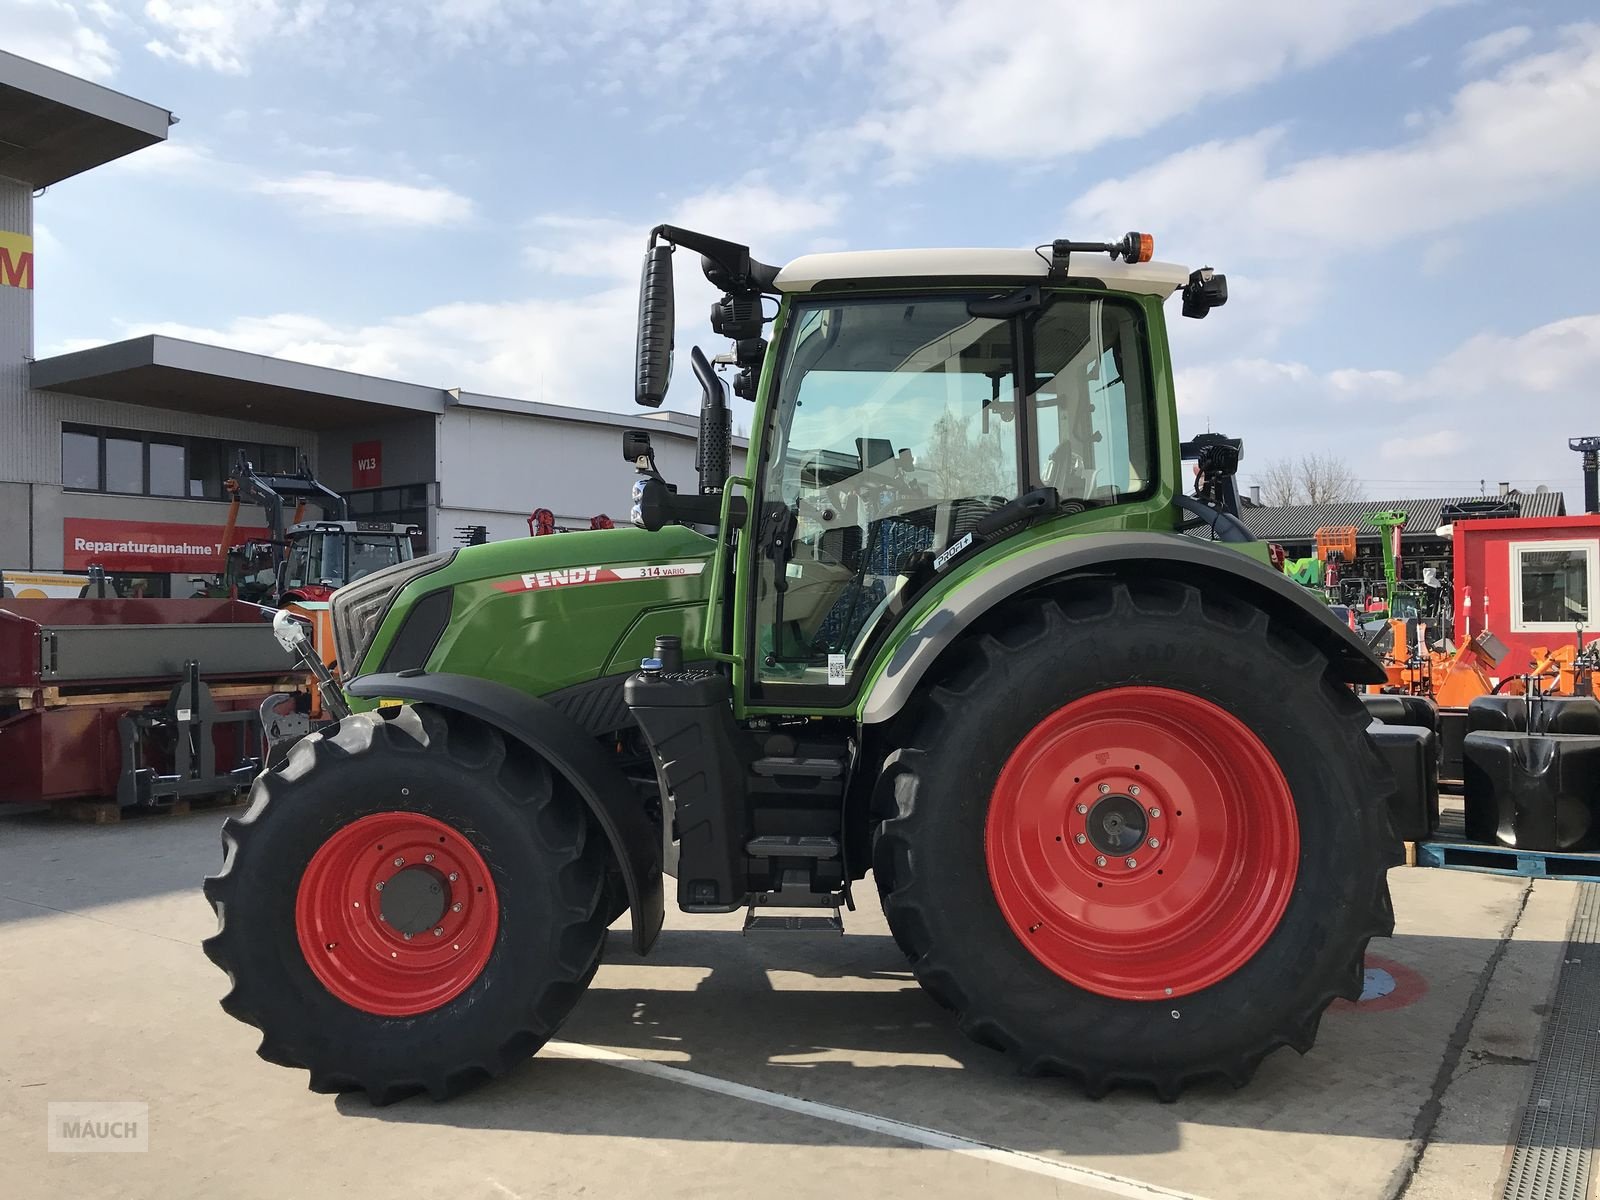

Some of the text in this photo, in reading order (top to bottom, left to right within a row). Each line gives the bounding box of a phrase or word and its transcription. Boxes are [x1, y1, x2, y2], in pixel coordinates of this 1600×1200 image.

[358, 458, 376, 471] W13
[74, 537, 212, 556] Reparaturannahme
[938, 541, 963, 565] PROFI
[521, 566, 685, 589] FENDT 314 VARIO
